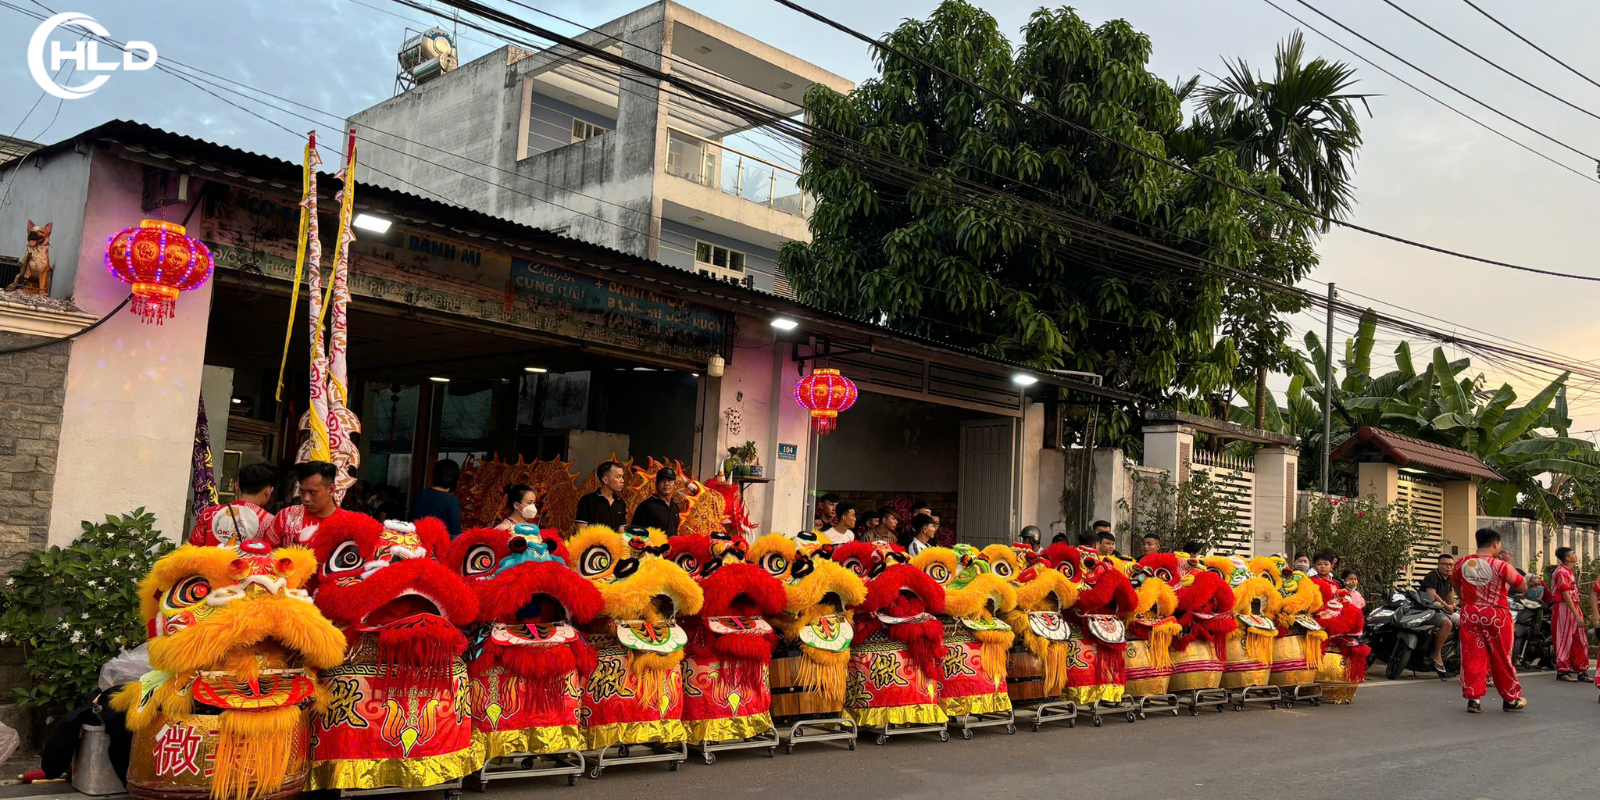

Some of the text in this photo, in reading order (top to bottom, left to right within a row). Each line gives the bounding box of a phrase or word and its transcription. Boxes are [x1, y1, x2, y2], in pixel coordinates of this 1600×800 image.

[515, 275, 555, 295] CUNG
[587, 657, 635, 703] 微
[870, 652, 909, 687] 微
